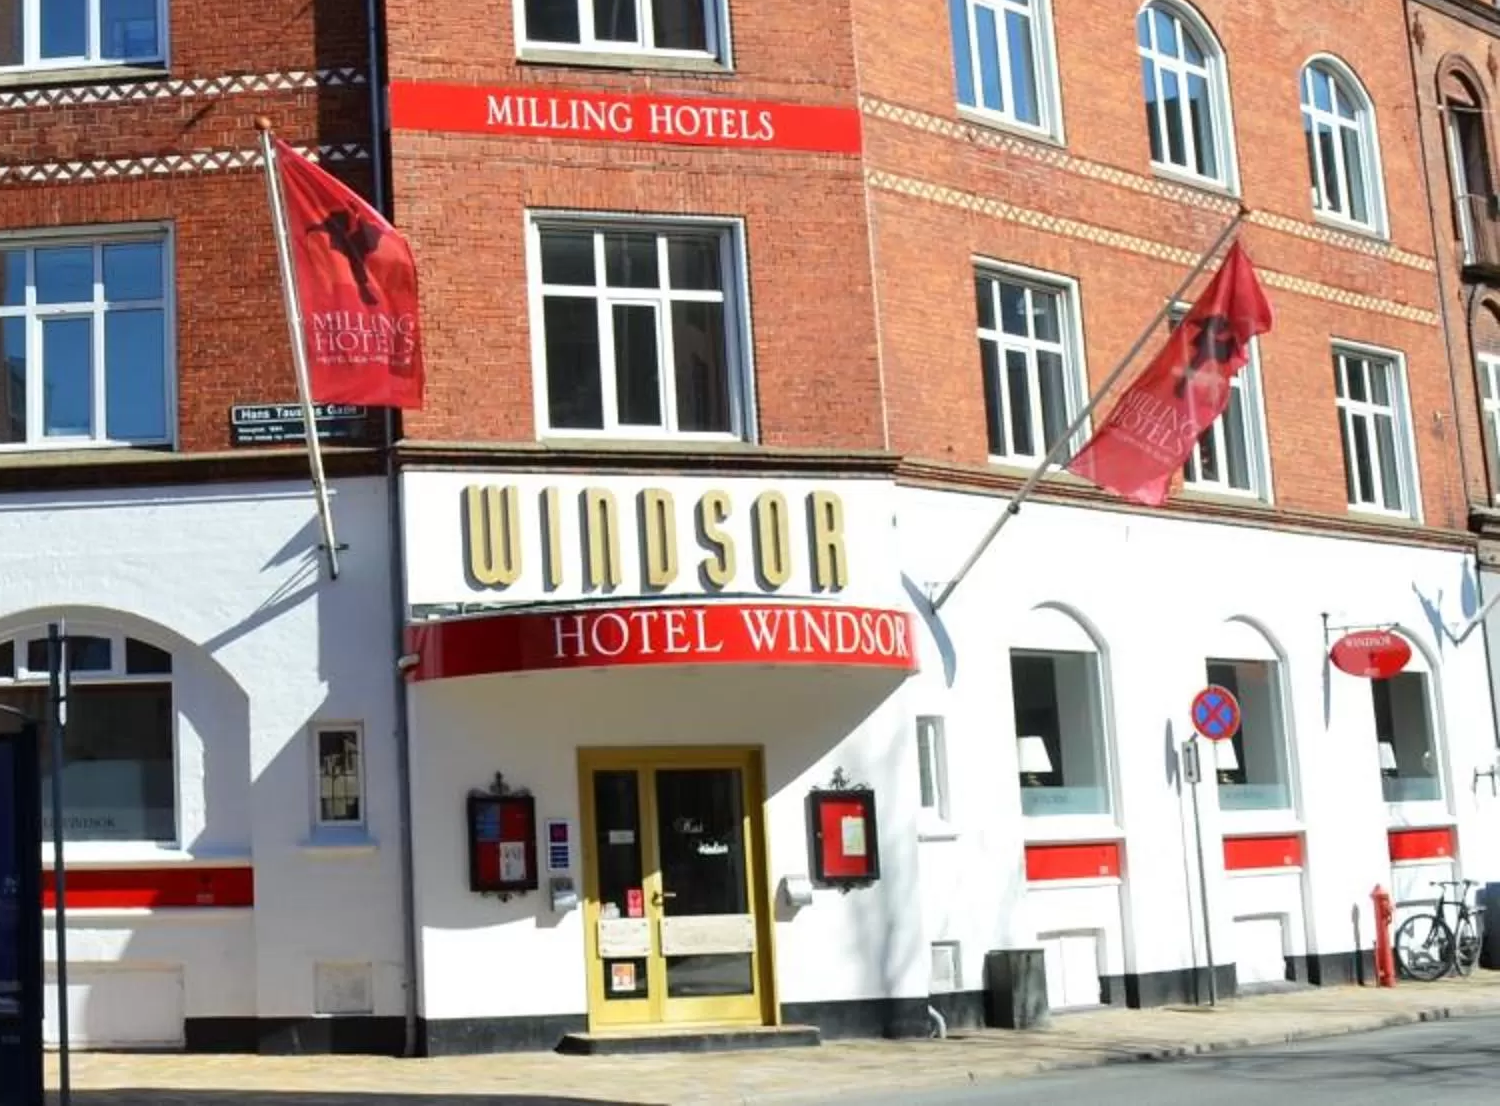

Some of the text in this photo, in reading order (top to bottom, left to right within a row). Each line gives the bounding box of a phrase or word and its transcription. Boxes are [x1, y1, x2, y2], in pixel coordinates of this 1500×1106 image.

[486, 94, 775, 141] MILLING HOTELS
[312, 310, 415, 335] MILLING
[315, 331, 415, 355] HOTELS
[241, 409, 271, 420] Hans
[462, 484, 849, 592] WINDSOR
[552, 608, 910, 658] HOTEL WINDSOR
